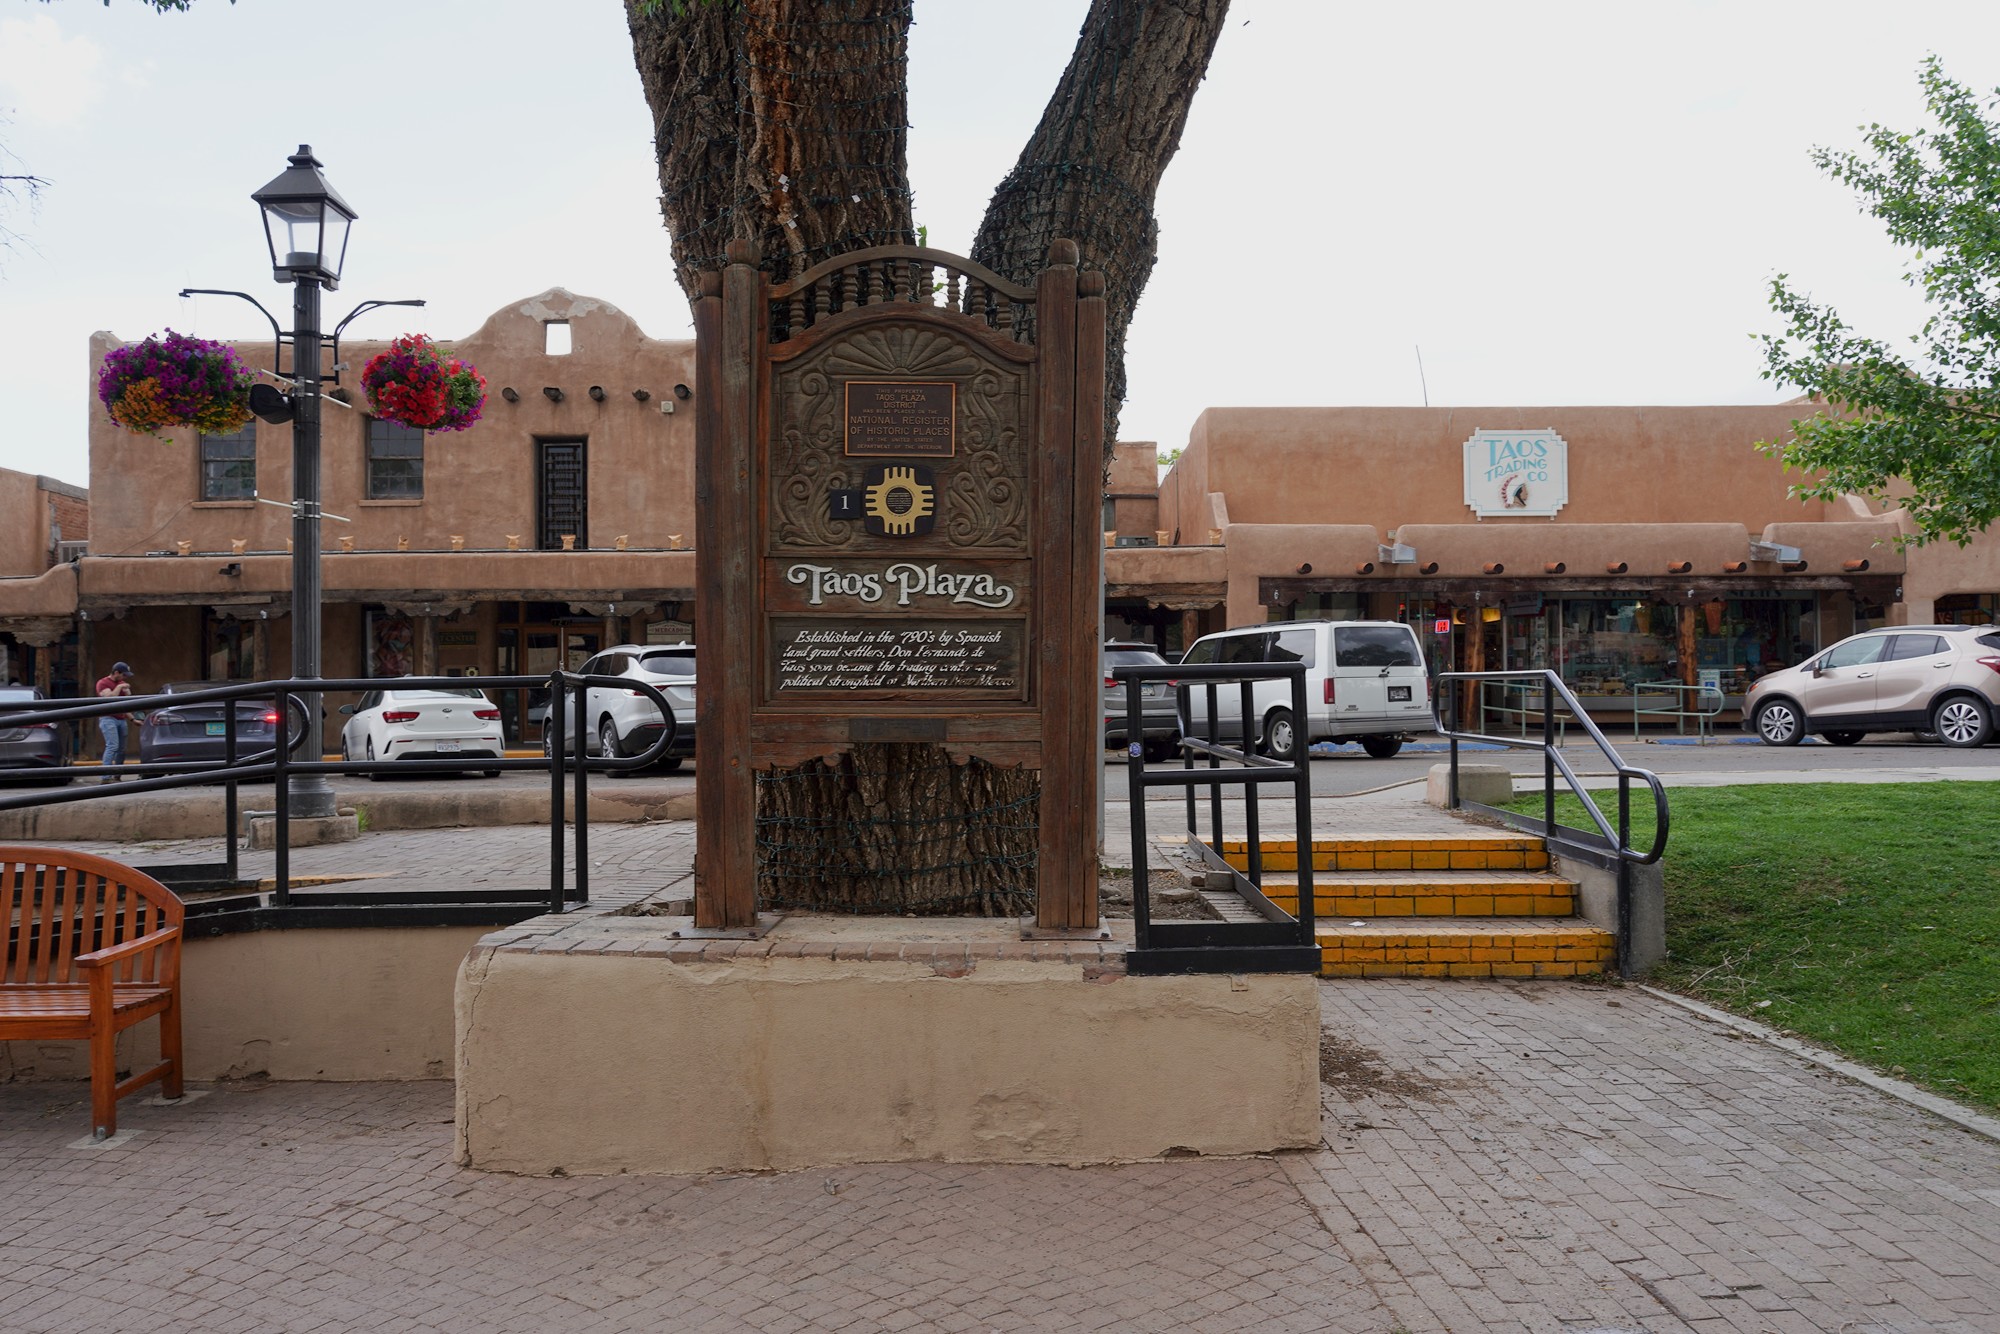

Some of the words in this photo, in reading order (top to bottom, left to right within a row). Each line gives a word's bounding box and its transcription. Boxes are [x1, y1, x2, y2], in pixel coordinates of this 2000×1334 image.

[883, 401, 917, 409] DISTRICT
[900, 394, 926, 402] PLAZA
[850, 416, 898, 424] NATIONAL
[902, 416, 950, 425] REGISTER
[850, 426, 863, 435] OF
[867, 426, 910, 435] HISTORIC
[913, 427, 950, 436] PLACES
[1483, 439, 1548, 466] TAOS
[1484, 458, 1548, 482] TRADING
[1527, 471, 1548, 482] CO
[840, 495, 849, 510] 1
[786, 563, 883, 605] Taos
[884, 562, 1014, 609] Plaza
[794, 630, 864, 642] Established
[862, 631, 876, 642] in
[876, 630, 896, 642] the
[938, 630, 954, 646] by
[955, 630, 1002, 646] Spanish
[806, 645, 843, 661] grant
[842, 645, 886, 658] settlers,
[887, 645, 912, 657] Don
[914, 645, 969, 657] Fernando
[970, 646, 986, 657] de
[780, 659, 806, 672] Taos
[808, 664, 834, 672] soon
[876, 660, 896, 672] the
[896, 660, 937, 674] trading
[779, 674, 828, 690] political
[827, 674, 886, 690] stronghold
[901, 674, 948, 687] Northern
